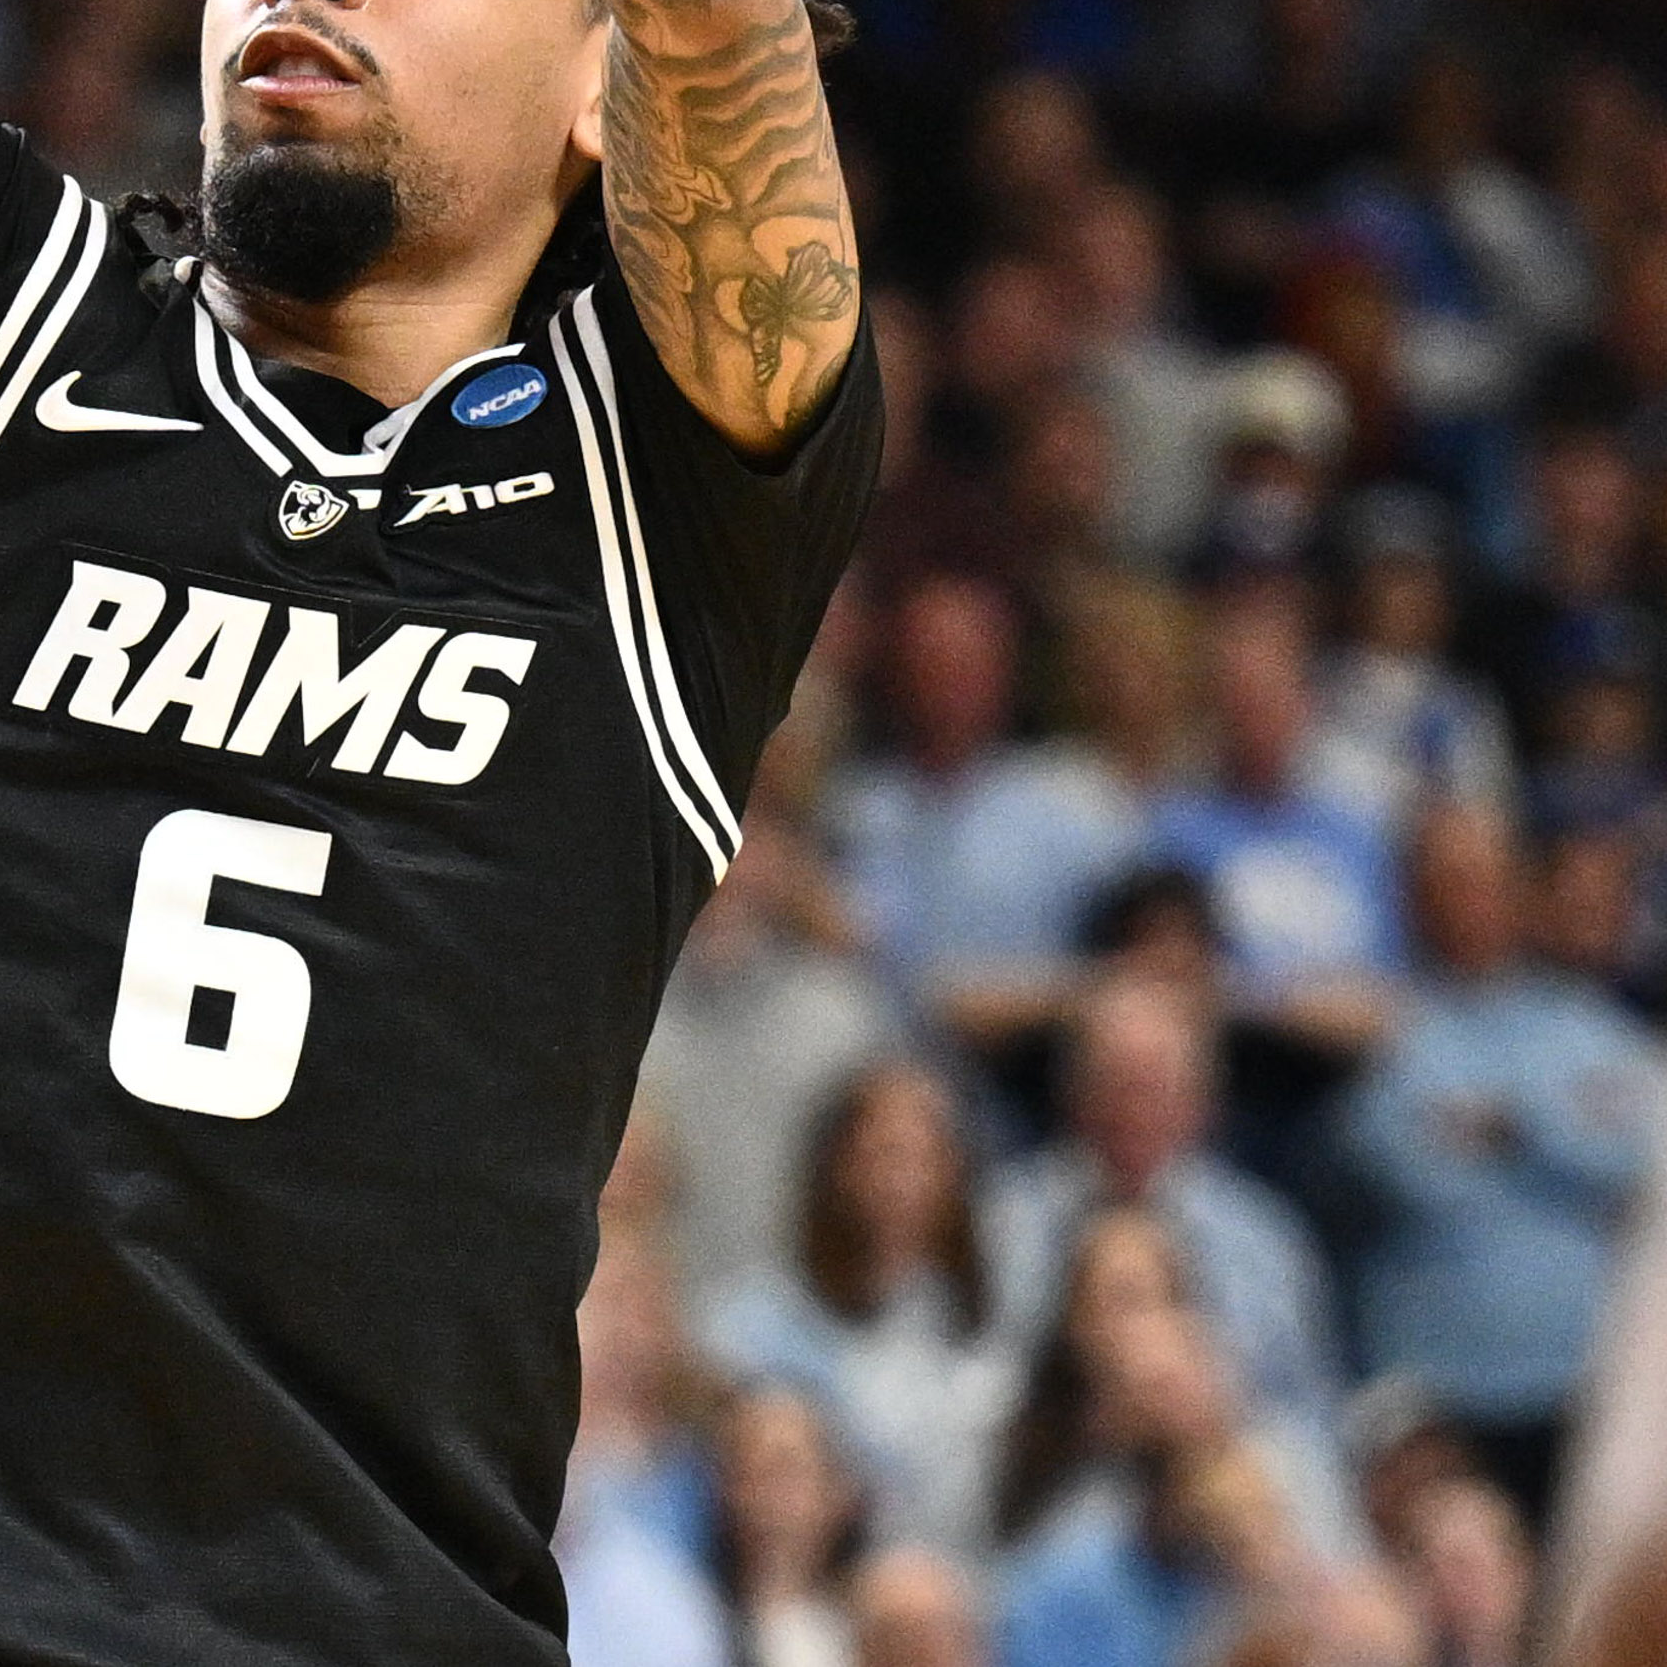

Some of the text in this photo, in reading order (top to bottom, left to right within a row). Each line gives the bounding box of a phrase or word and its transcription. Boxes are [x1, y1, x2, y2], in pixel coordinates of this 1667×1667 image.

[468, 378, 542, 421] NCAA
[11, 558, 539, 786] RAMS
[108, 808, 333, 1121] 6
